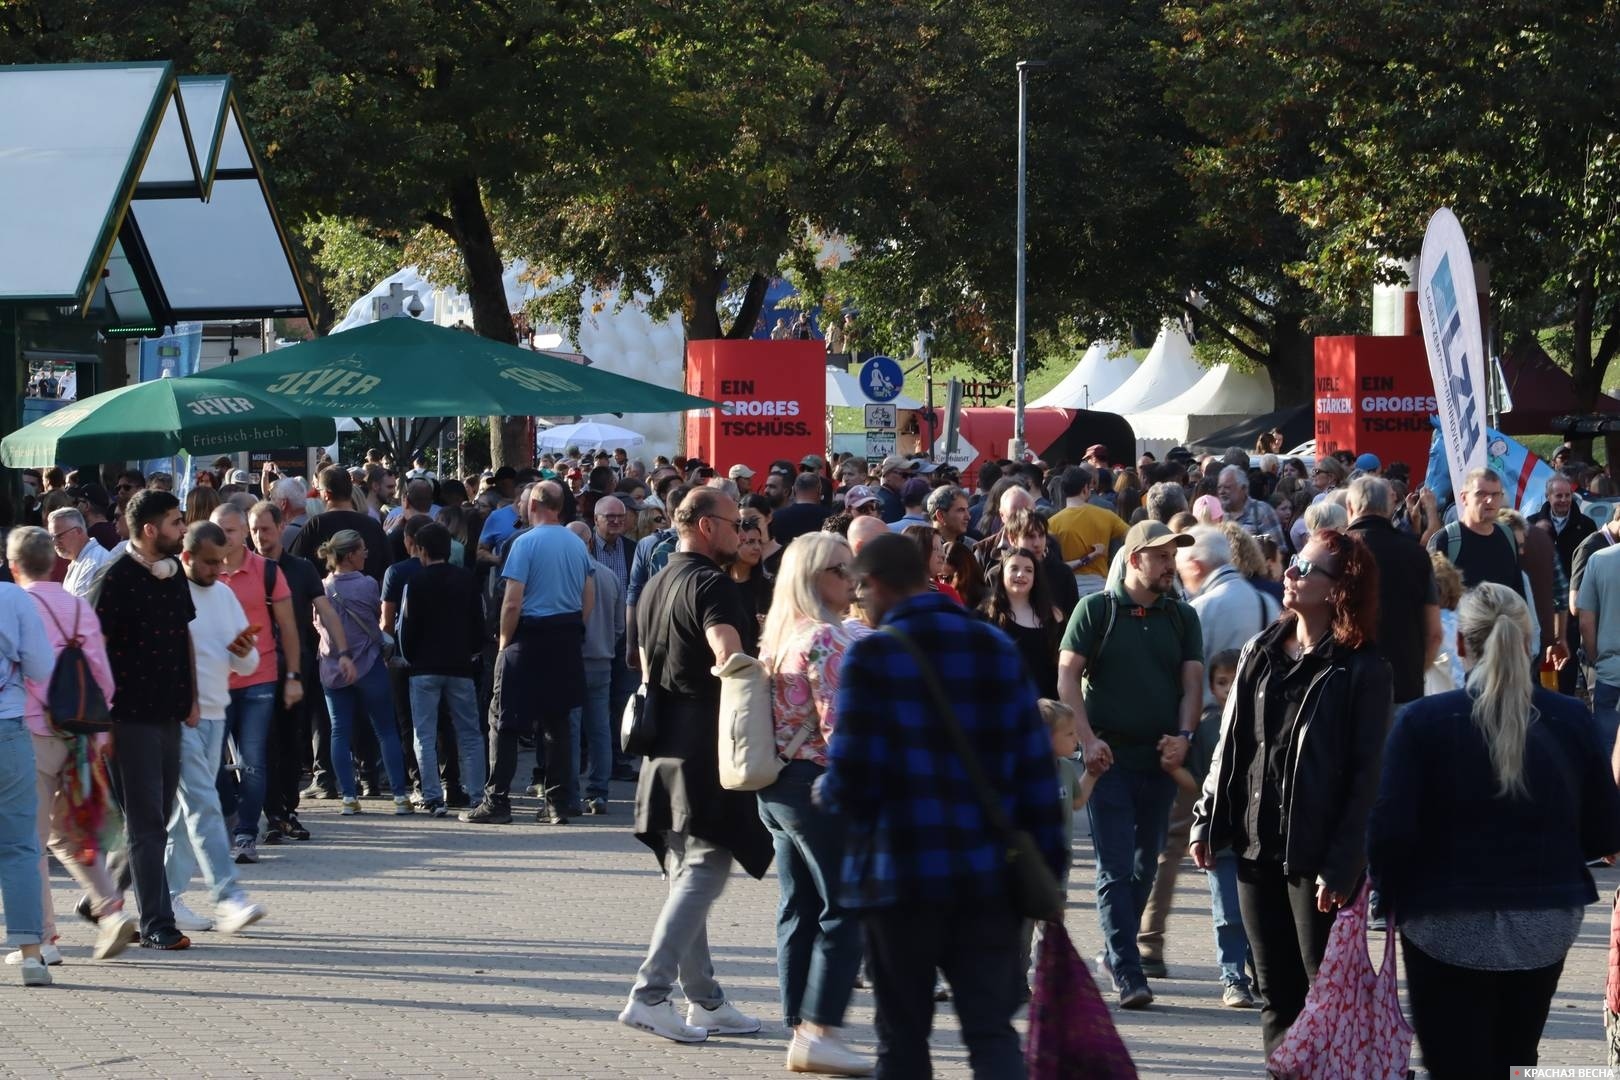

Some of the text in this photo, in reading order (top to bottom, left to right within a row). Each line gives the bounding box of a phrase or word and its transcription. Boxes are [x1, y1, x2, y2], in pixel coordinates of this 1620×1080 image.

[265, 368, 382, 395] JEVER
[721, 380, 754, 395] EIN
[1317, 377, 1339, 392] VIELE
[1362, 376, 1394, 391] EIN
[186, 397, 255, 415] JEVER
[1316, 393, 1353, 414] STÄRKEN.
[721, 417, 811, 436] TSCHÜSS.
[1317, 420, 1331, 435] EIN
[1445, 388, 1460, 452] HANNOVER
[193, 425, 288, 447] Friesisch-herb.
